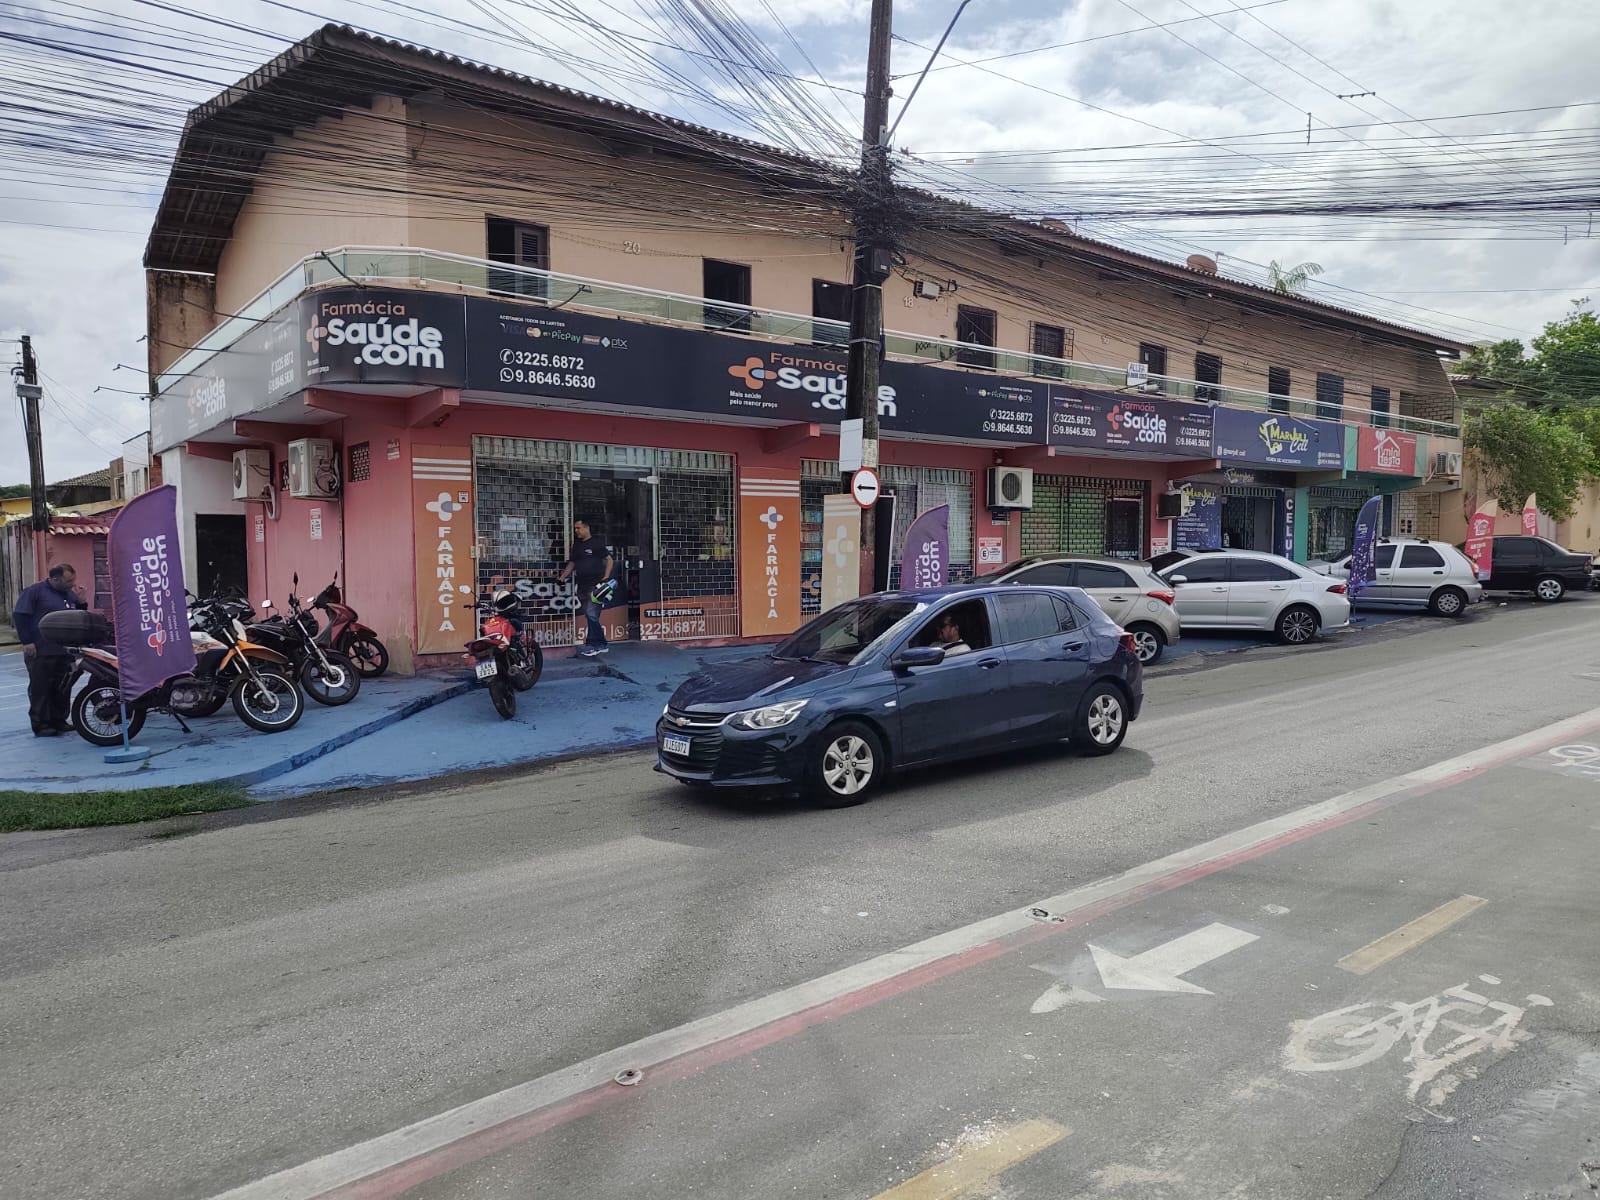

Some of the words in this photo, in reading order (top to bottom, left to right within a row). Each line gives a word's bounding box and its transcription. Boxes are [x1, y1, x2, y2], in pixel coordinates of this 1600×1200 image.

[624, 241, 640, 255] 20
[322, 301, 405, 317] Farmácia
[326, 317, 443, 347] Saúde
[551, 330, 581, 343] PicPay
[354, 342, 444, 369] .com
[515, 351, 584, 370] 3225.6872
[515, 369, 596, 389] 9.8646.5630
[776, 367, 896, 401] Saúe
[196, 375, 225, 407] Saúde
[204, 394, 226, 418] .com
[1121, 400, 1156, 412] Farmácia
[997, 410, 1033, 423] 3225.6872
[1060, 414, 1091, 425] 3225.6872
[1123, 411, 1167, 431] Saúde
[990, 422, 1033, 435] 9.8646.5630
[1059, 426, 1097, 437] 9.8646.5630
[1135, 430, 1167, 444] .com
[155, 534, 171, 597] .com
[141, 537, 164, 624] Saúde
[436, 526, 455, 632] FARMÁCIA
[132, 562, 151, 631] Farmácia
[646, 608, 703, 618] TELE-ENTREGA
